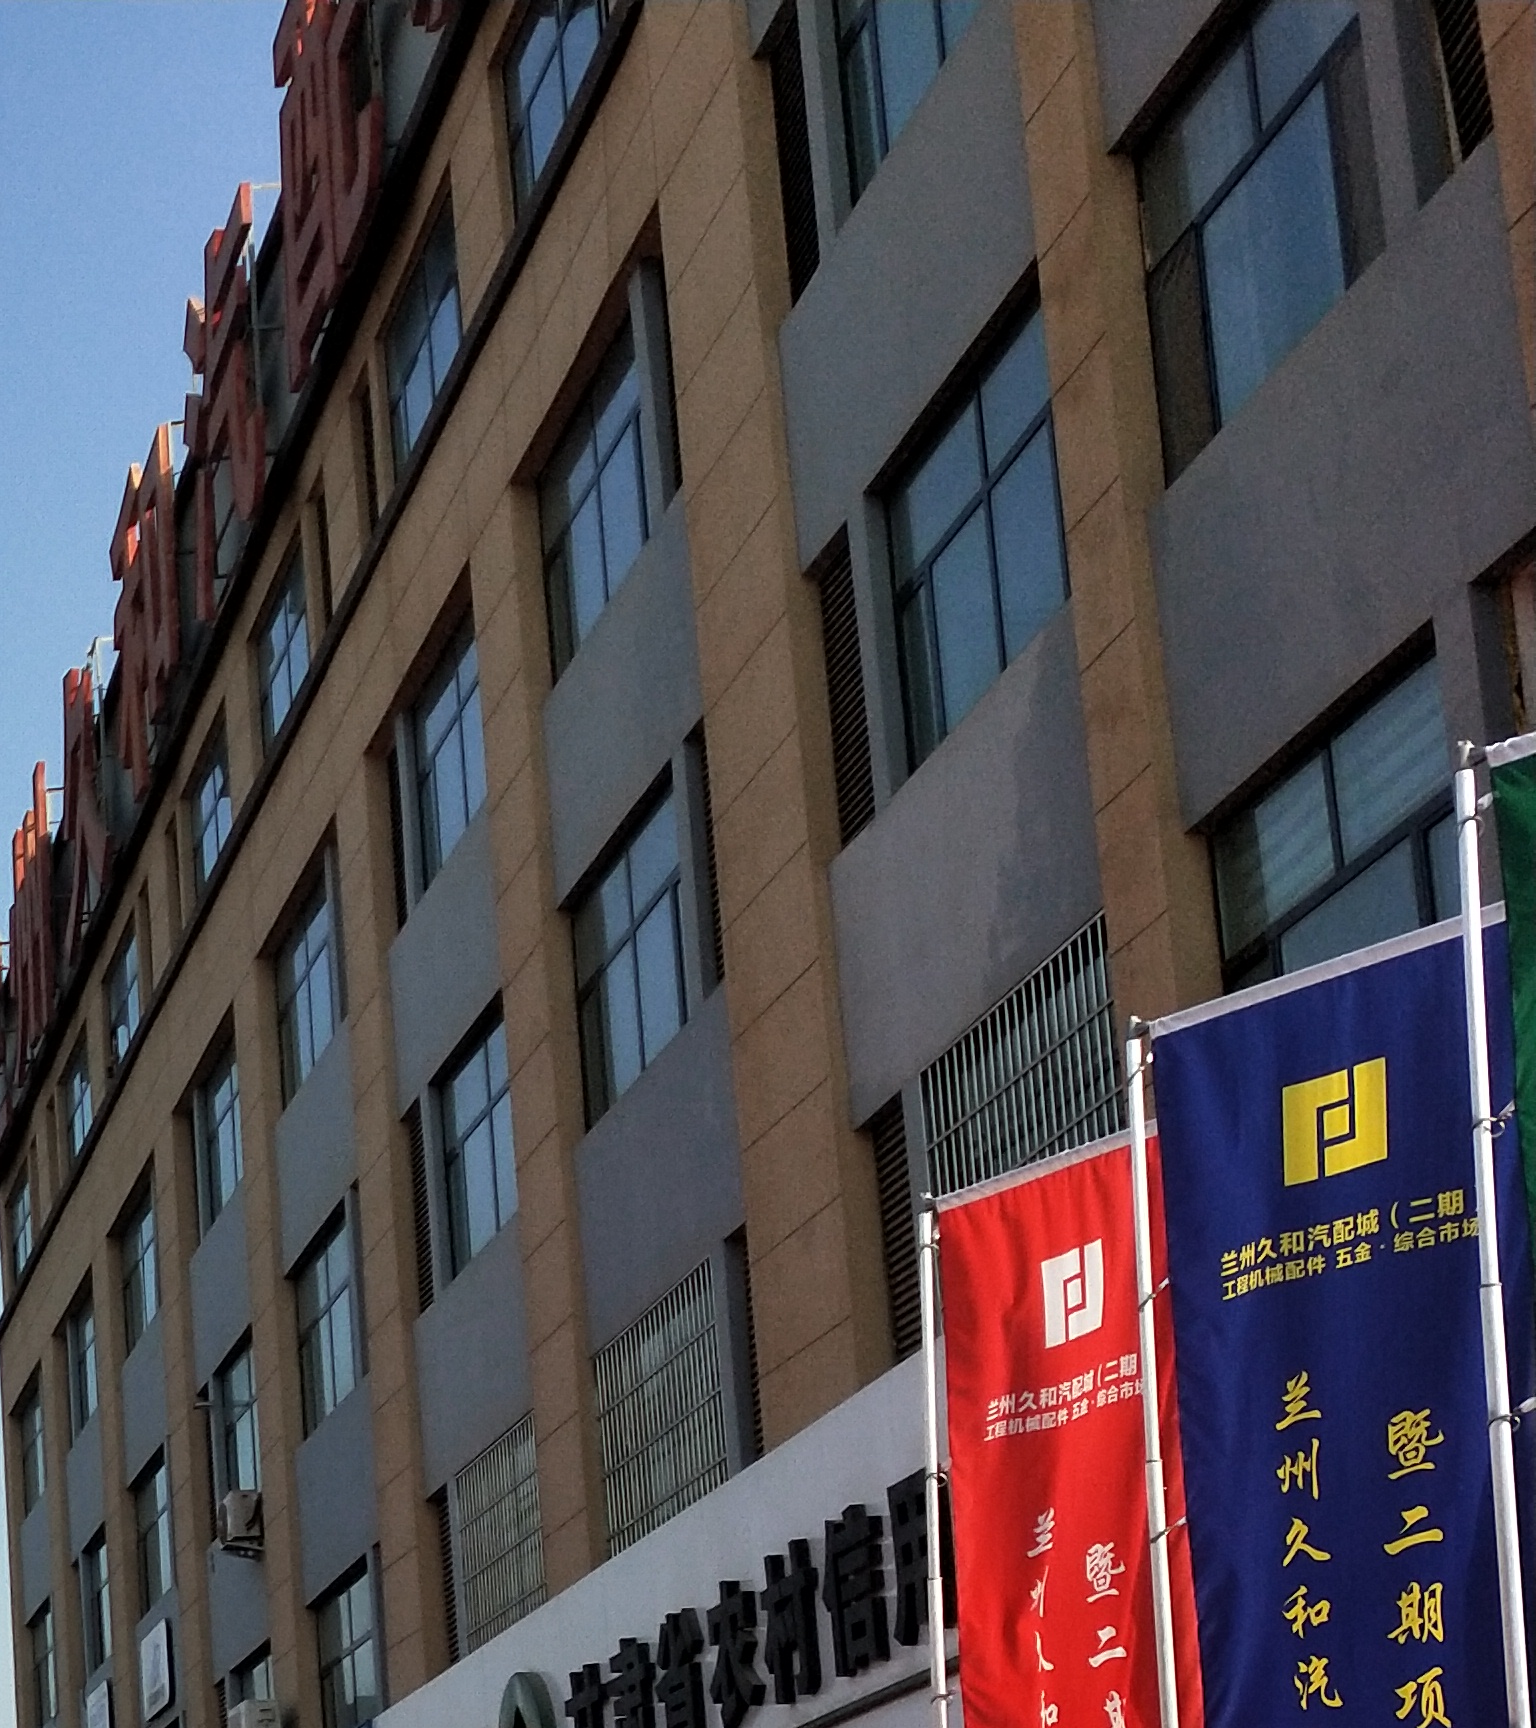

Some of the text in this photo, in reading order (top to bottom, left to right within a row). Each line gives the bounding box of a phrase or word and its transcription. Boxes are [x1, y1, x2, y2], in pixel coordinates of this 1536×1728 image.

[1222, 1257, 1326, 1301] 工程机械配件
